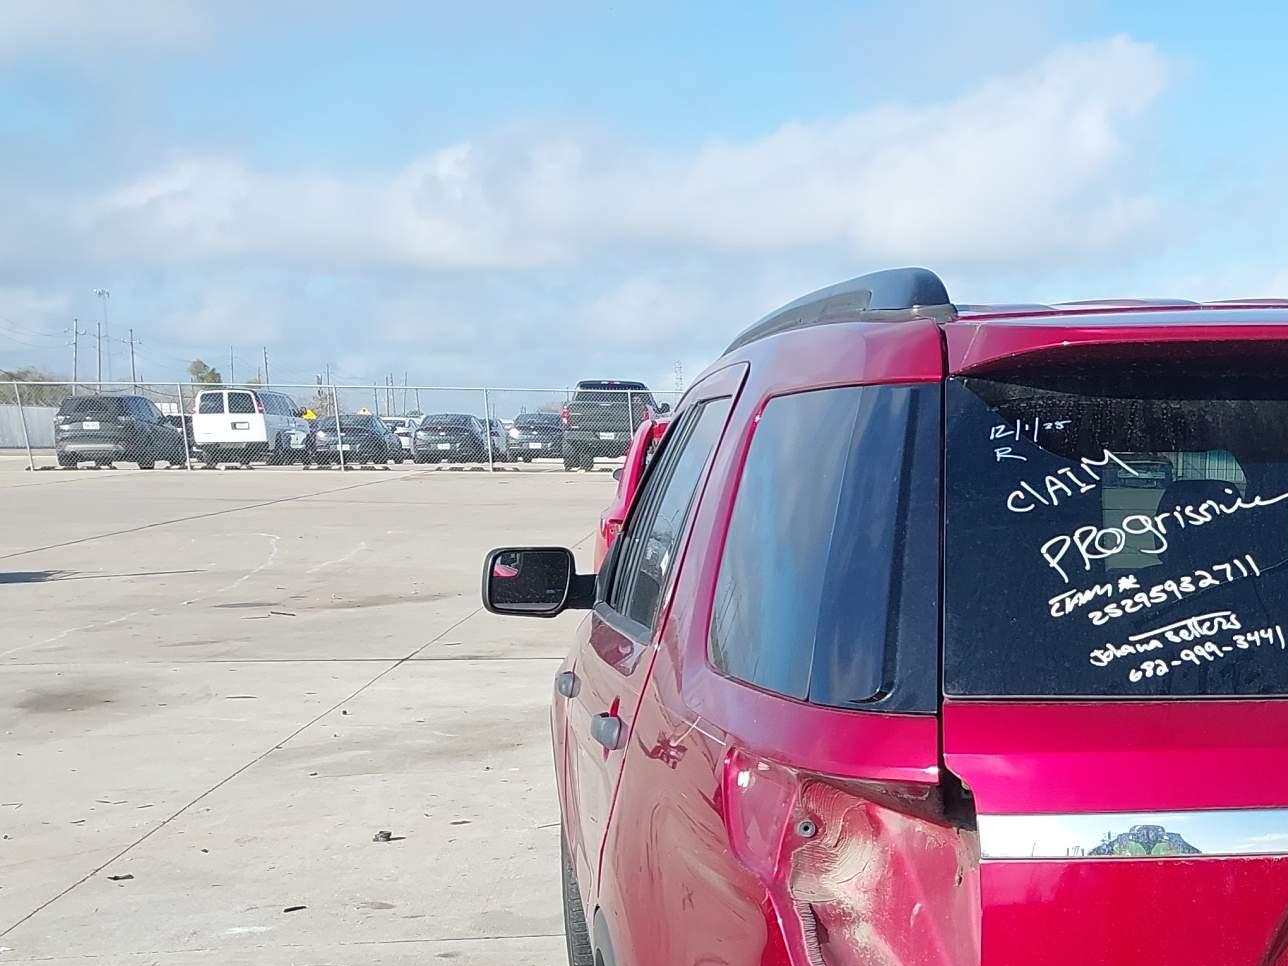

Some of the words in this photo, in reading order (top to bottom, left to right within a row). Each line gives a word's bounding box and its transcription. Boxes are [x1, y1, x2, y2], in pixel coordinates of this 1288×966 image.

[993, 447, 1028, 462] R
[1088, 553, 1261, 626] 25295932711
[1129, 625, 1286, 683] 682-999-3441
